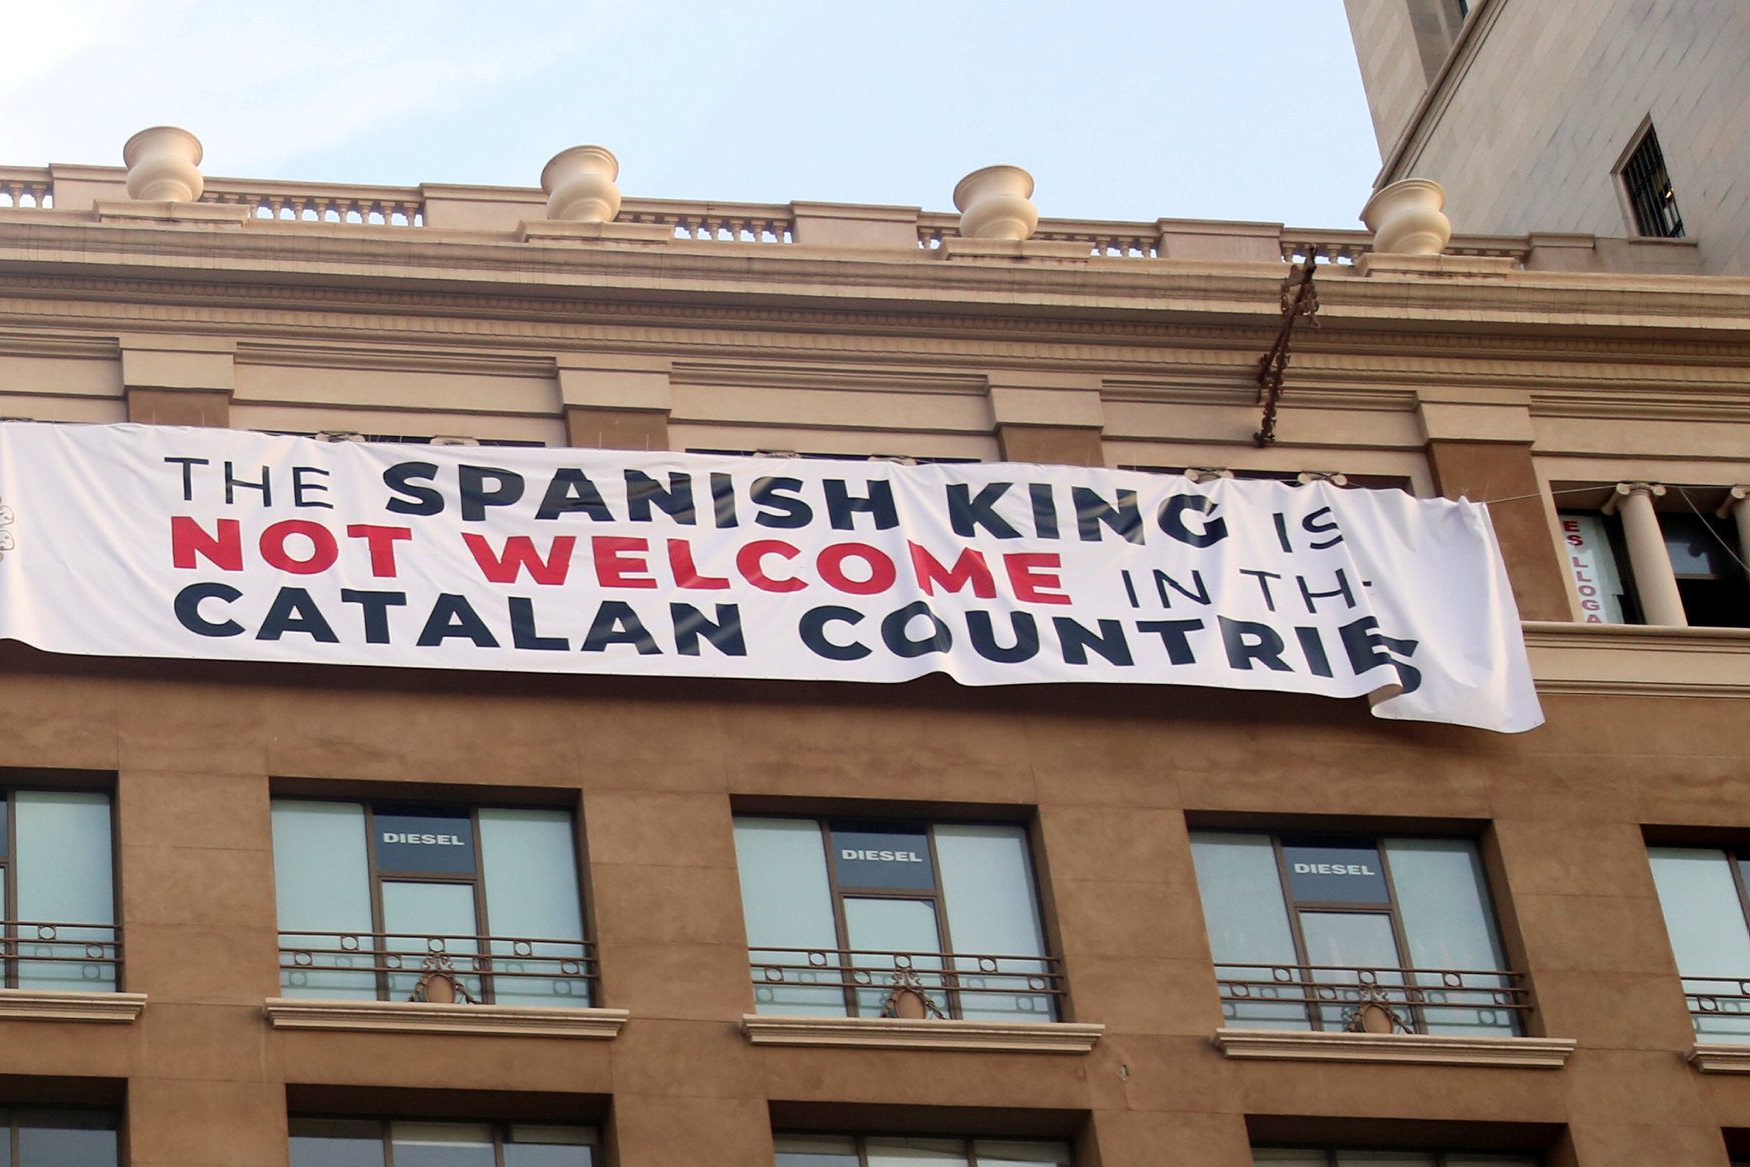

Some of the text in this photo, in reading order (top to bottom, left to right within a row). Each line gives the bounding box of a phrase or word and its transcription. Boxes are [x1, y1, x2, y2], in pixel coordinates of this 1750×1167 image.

[164, 456, 1345, 553] THE SPANISH KING IS
[170, 515, 1372, 614] NOT WELCOME IN TH
[173, 581, 749, 657] CATALAN
[382, 832, 466, 846] DIESEL
[841, 849, 923, 862] DIESEL
[1293, 863, 1376, 876] DIESEL
